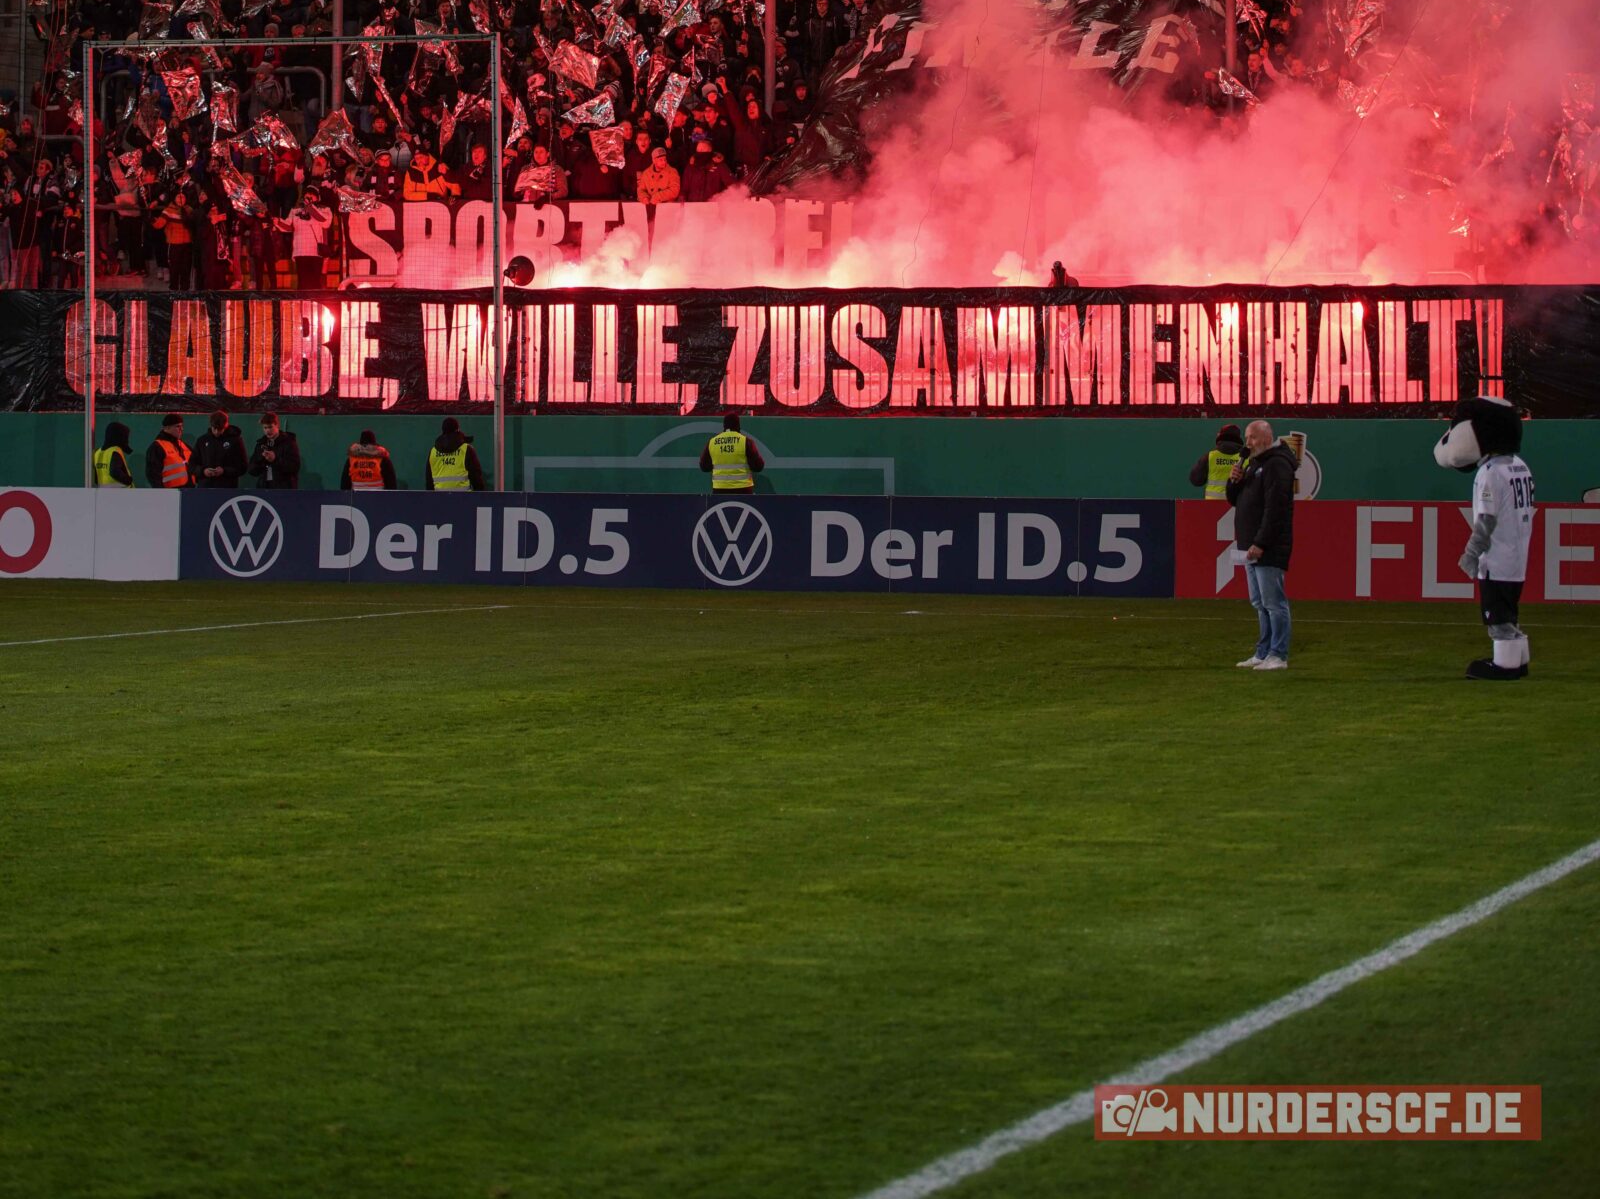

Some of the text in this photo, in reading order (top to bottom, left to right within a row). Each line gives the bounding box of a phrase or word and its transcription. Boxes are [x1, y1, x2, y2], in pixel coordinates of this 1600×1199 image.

[65, 298, 1504, 416] GLAUBE, WILLE, ZUSAMMENHALT!
[714, 436, 741, 446] SECURITY
[1216, 458, 1239, 466] SECURIT
[319, 504, 631, 575] Der ID.5
[810, 510, 1144, 583] Der ID.5
